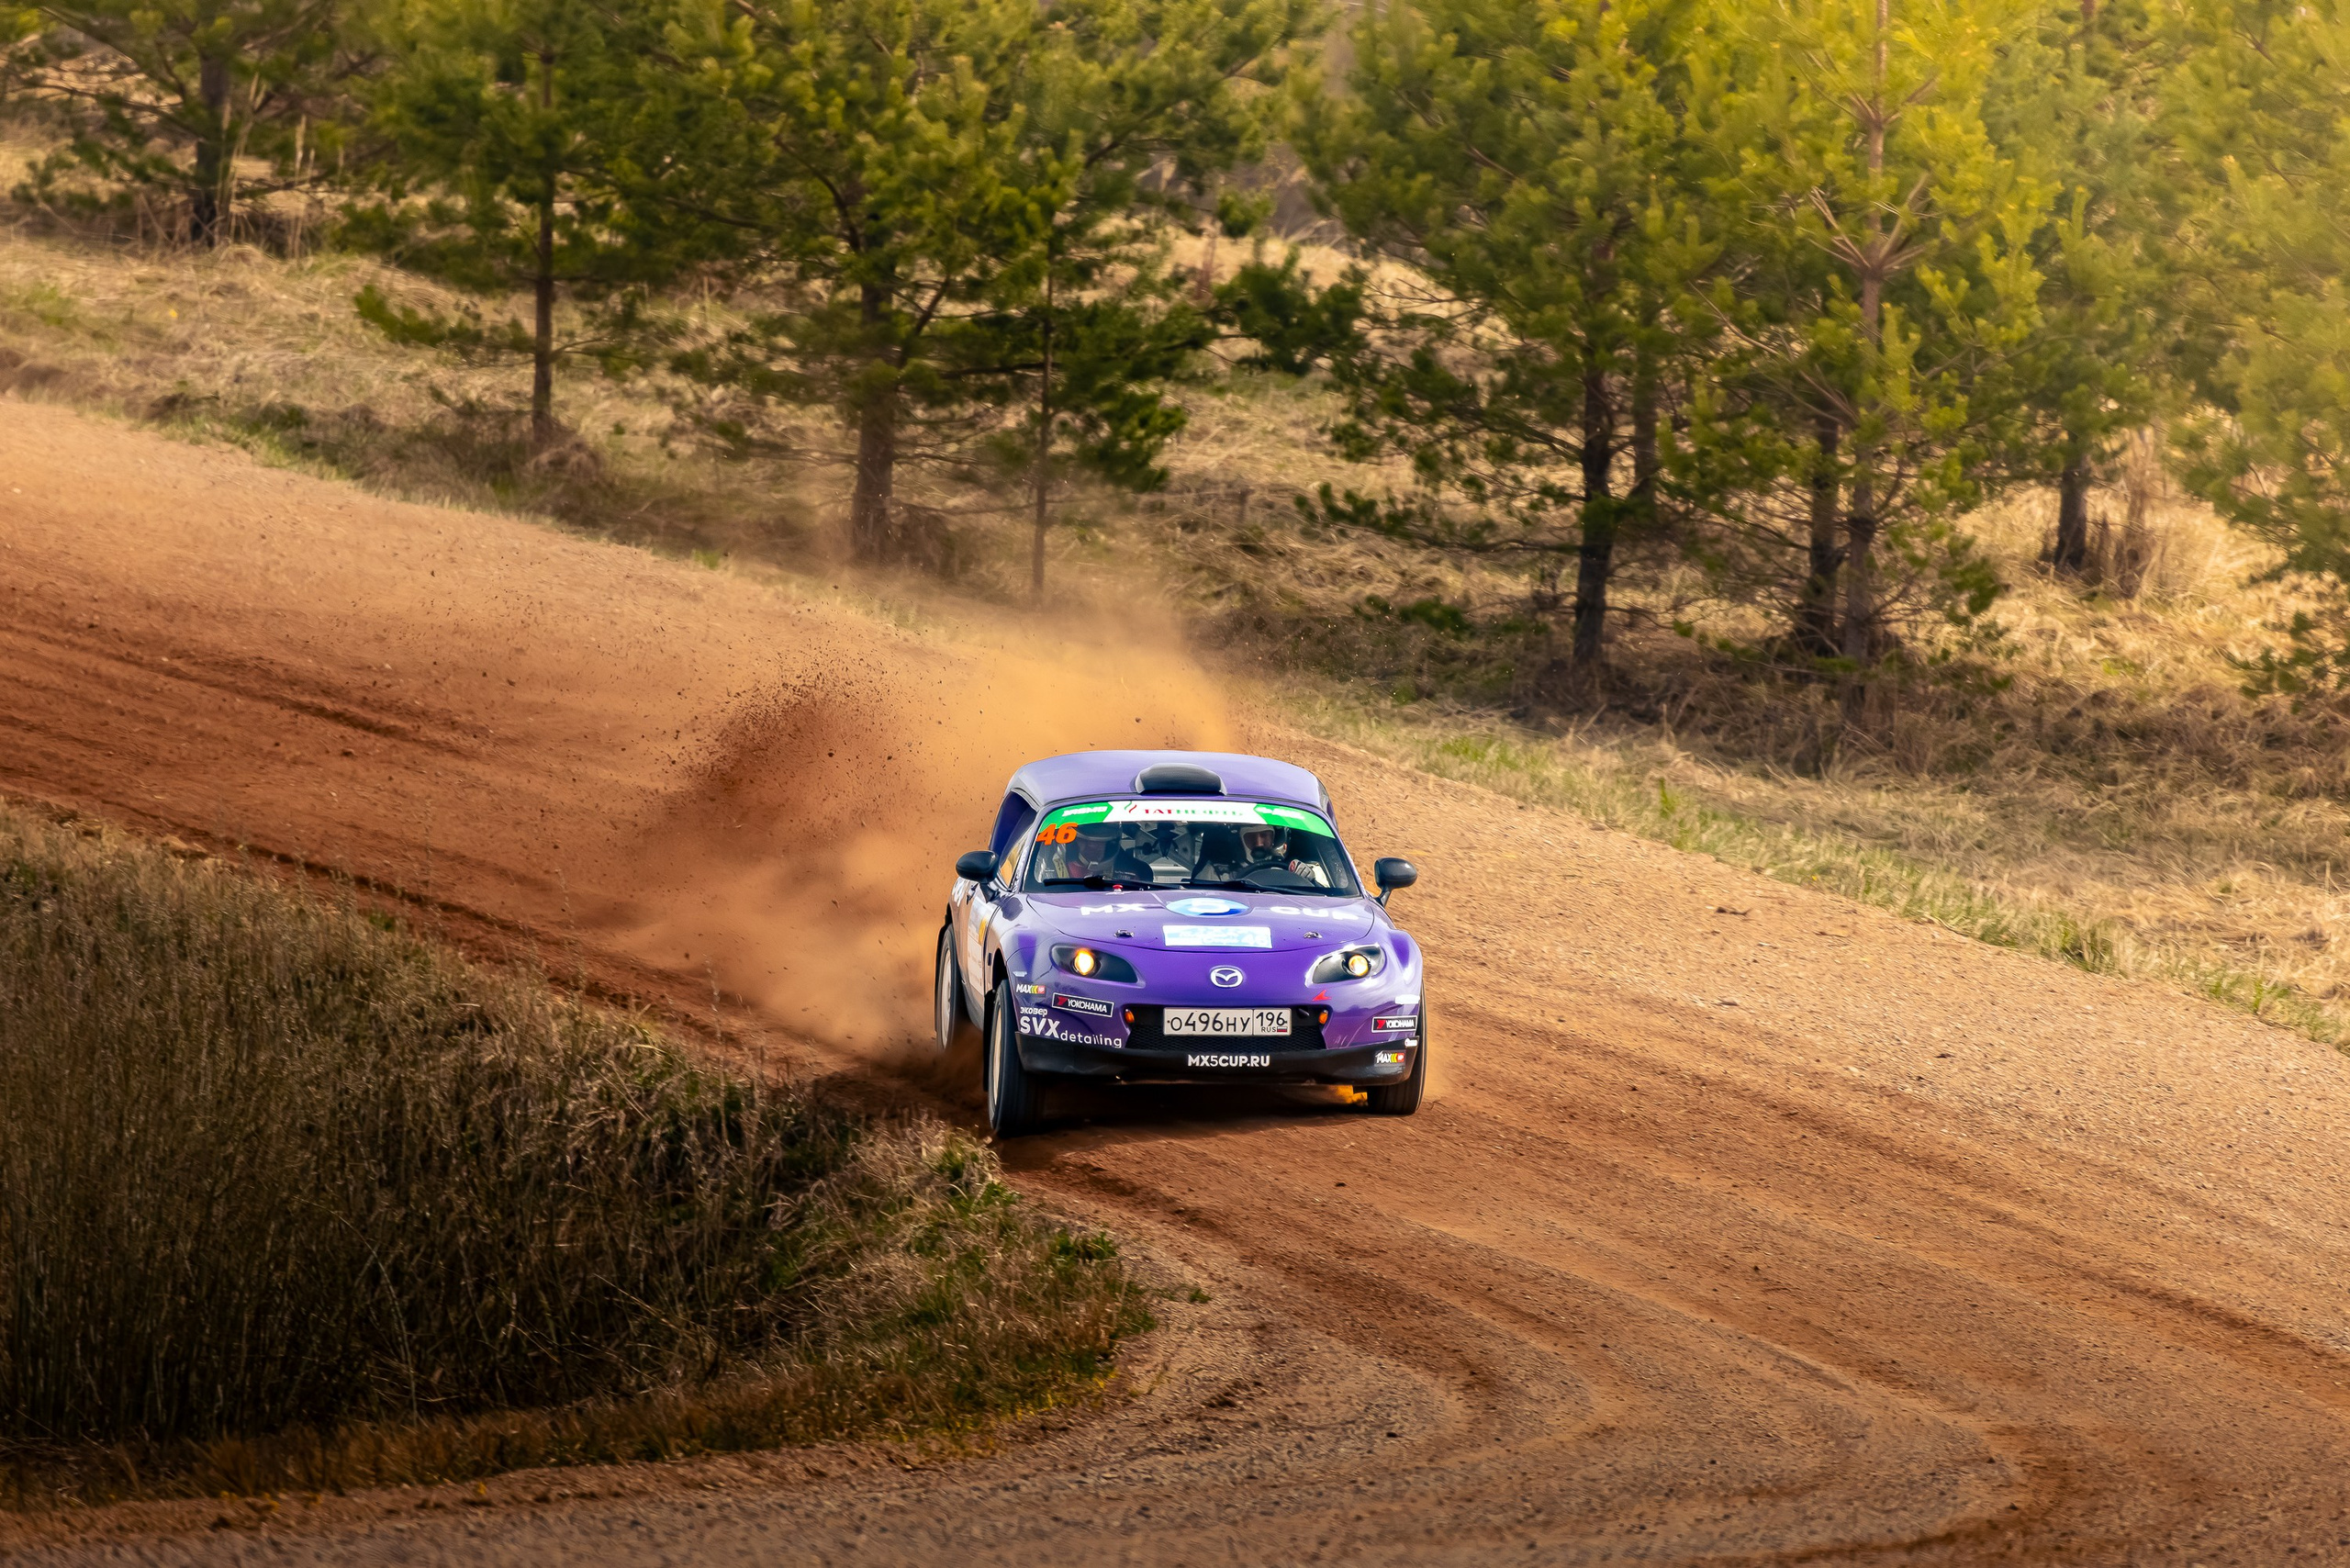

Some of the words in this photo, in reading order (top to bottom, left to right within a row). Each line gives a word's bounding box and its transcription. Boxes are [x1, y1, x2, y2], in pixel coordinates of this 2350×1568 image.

[1036, 823, 1079, 846] 46
[1080, 903, 1146, 915] MX
[1190, 899, 1231, 914] 5
[1270, 906, 1359, 921] CUP
[1016, 983, 1032, 994] MAX
[1068, 998, 1108, 1014] YOKOHAMA
[1256, 1012, 1285, 1026] 196
[1385, 1019, 1415, 1028] YOKOHAMA
[1188, 1054, 1270, 1067] MX5CUP.RU
